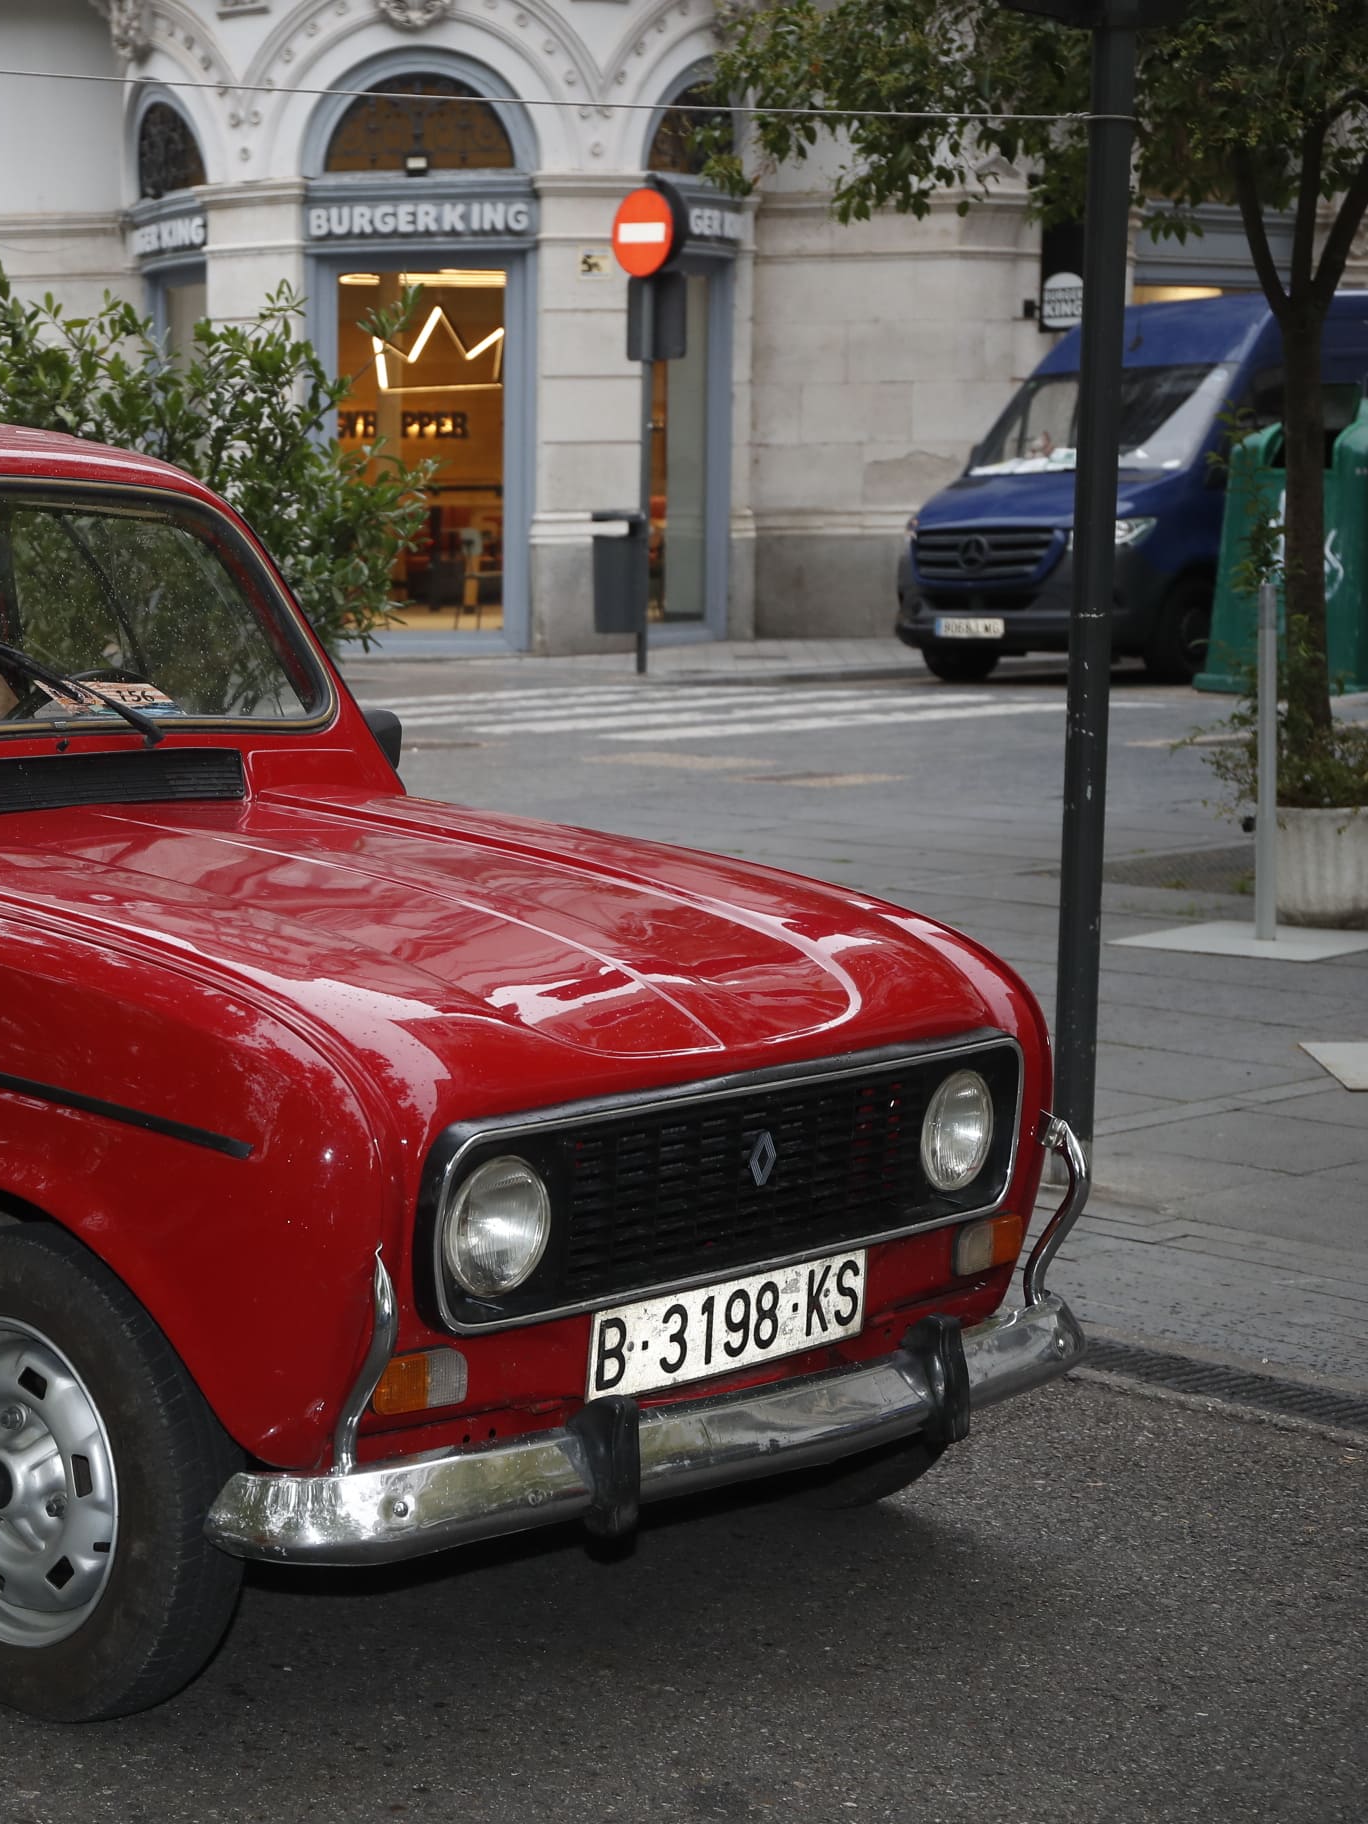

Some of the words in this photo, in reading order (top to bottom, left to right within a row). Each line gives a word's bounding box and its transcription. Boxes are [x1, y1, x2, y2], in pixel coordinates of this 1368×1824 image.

[160, 216, 205, 248] KING
[309, 204, 438, 236] BURGER
[442, 202, 530, 231] KING
[338, 411, 468, 439] WHPPER
[118, 690, 155, 702] 156
